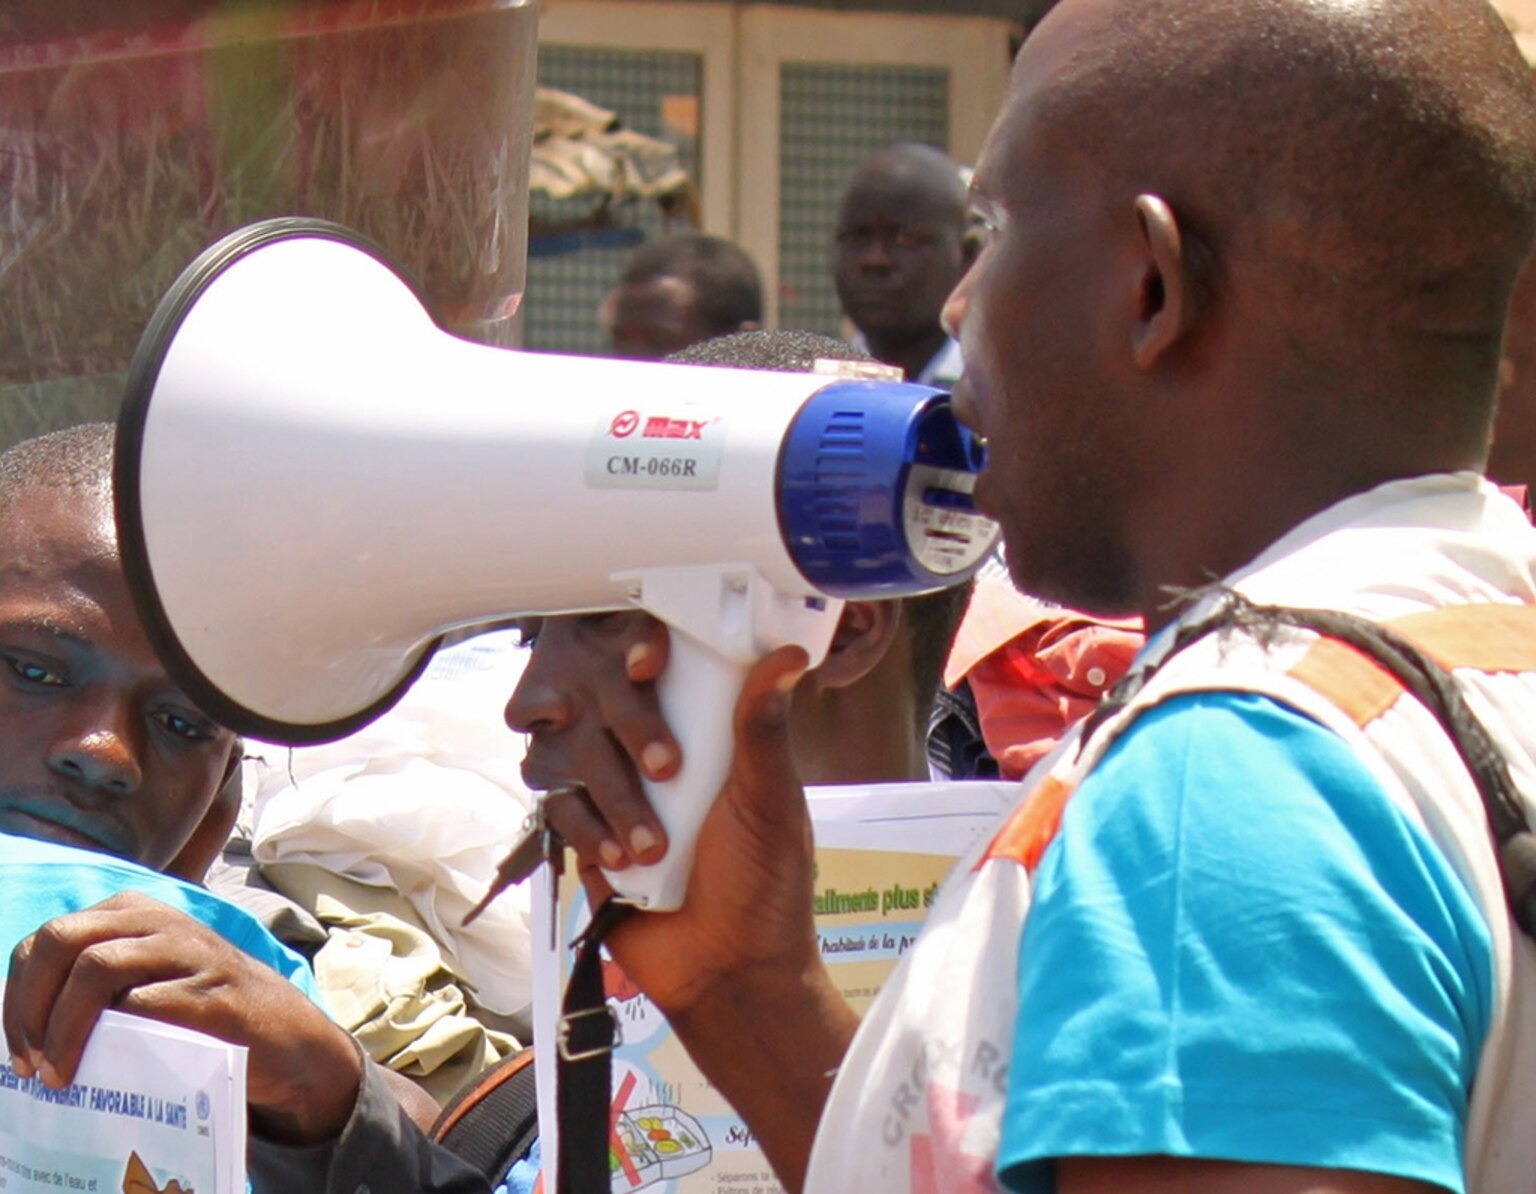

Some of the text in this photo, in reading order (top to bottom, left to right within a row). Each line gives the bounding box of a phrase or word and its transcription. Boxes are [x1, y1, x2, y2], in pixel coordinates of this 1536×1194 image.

[606, 455, 698, 477] CM-066R
[882, 882, 920, 916] plus
[882, 932, 895, 949] la
[90, 1086, 144, 1118] FAVORABLE
